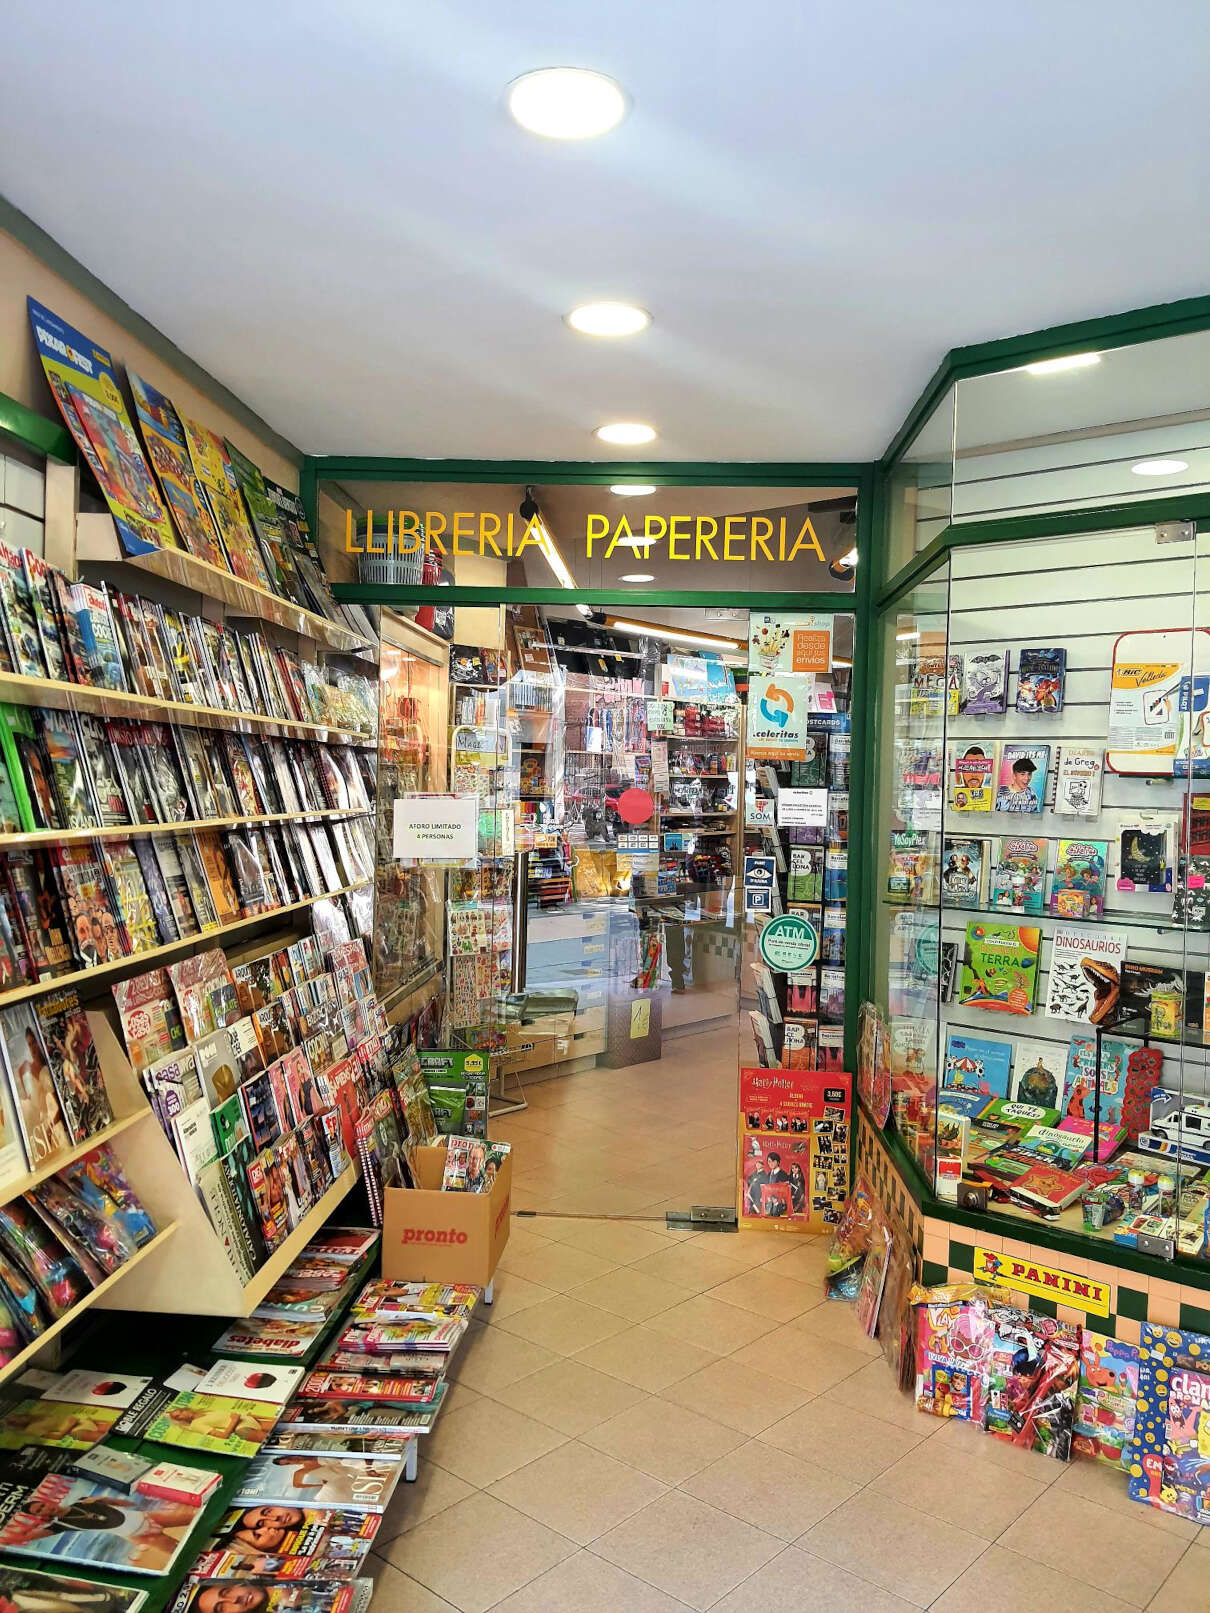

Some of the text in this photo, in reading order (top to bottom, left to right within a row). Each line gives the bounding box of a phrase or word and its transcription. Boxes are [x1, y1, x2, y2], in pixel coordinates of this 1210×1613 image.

[345, 508, 827, 563] LLIBRERIA PAPERERIA
[797, 641, 826, 650] desde
[1123, 669, 1141, 677] BIC
[1007, 751, 1025, 761] DAVID
[1064, 757, 1096, 770] de Greg
[750, 812, 771, 820] SOM
[431, 823, 462, 831] LIMITADO
[421, 833, 454, 841] PERSONAS
[774, 926, 806, 940] ATM
[1055, 935, 1121, 954] DINOSAURIOS
[980, 953, 1020, 967] TERRA
[1083, 1066, 1107, 1080] SOS
[401, 1227, 468, 1245] pronto
[1011, 1261, 1103, 1302] PANINI
[228, 1335, 301, 1349] diabetes
[135, 1388, 157, 1412] REGALO
